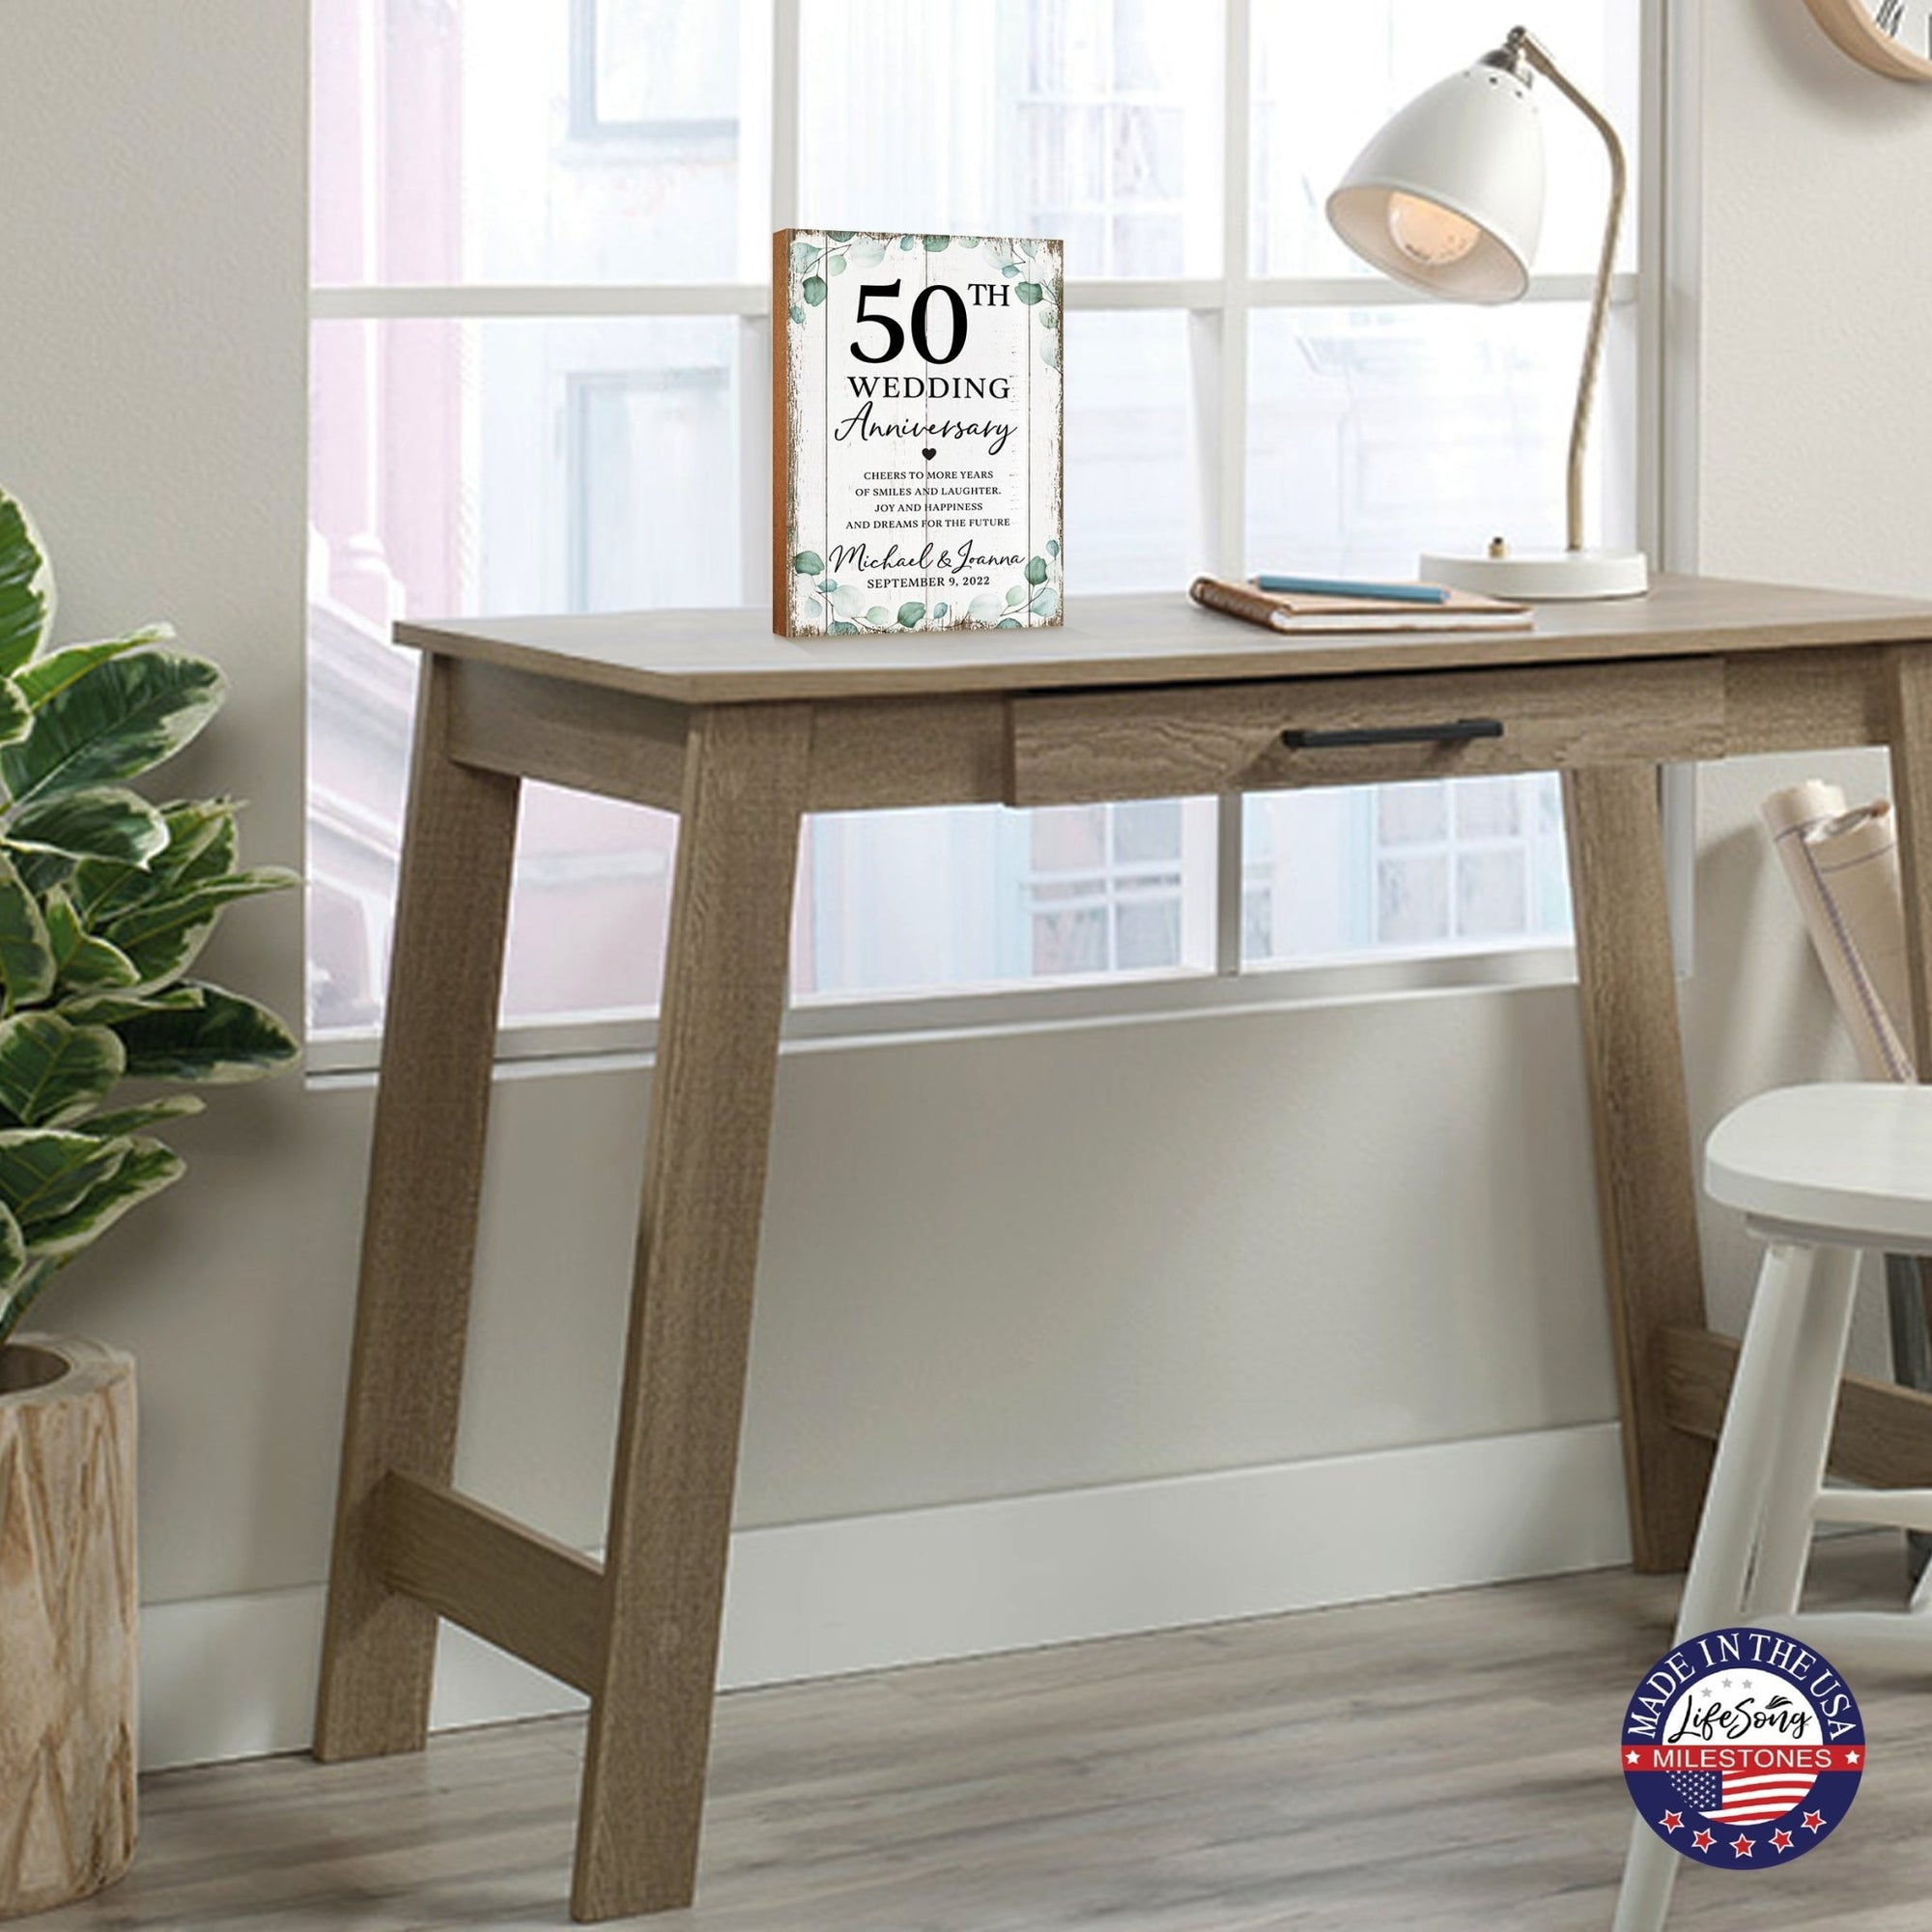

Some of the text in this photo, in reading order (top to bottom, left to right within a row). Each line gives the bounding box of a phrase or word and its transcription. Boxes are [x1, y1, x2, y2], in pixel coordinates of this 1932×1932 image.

[847, 376, 1010, 399] WEDDING
[835, 401, 1018, 456] Anniversary
[864, 471, 907, 480] CHEERS
[909, 471, 924, 480] TO
[960, 470, 994, 479] YEARS
[855, 488, 870, 497] OF
[872, 488, 912, 497] SMILES
[941, 487, 1002, 496] LAUGHTER.
[874, 502, 983, 513] JOY AND HAPPINESS
[846, 518, 1010, 529] AND DREAMS FOR THE FUTURE
[829, 539, 1026, 574] Michael & Joanna
[867, 576, 990, 589] SEPTEMBER 9, 2022
